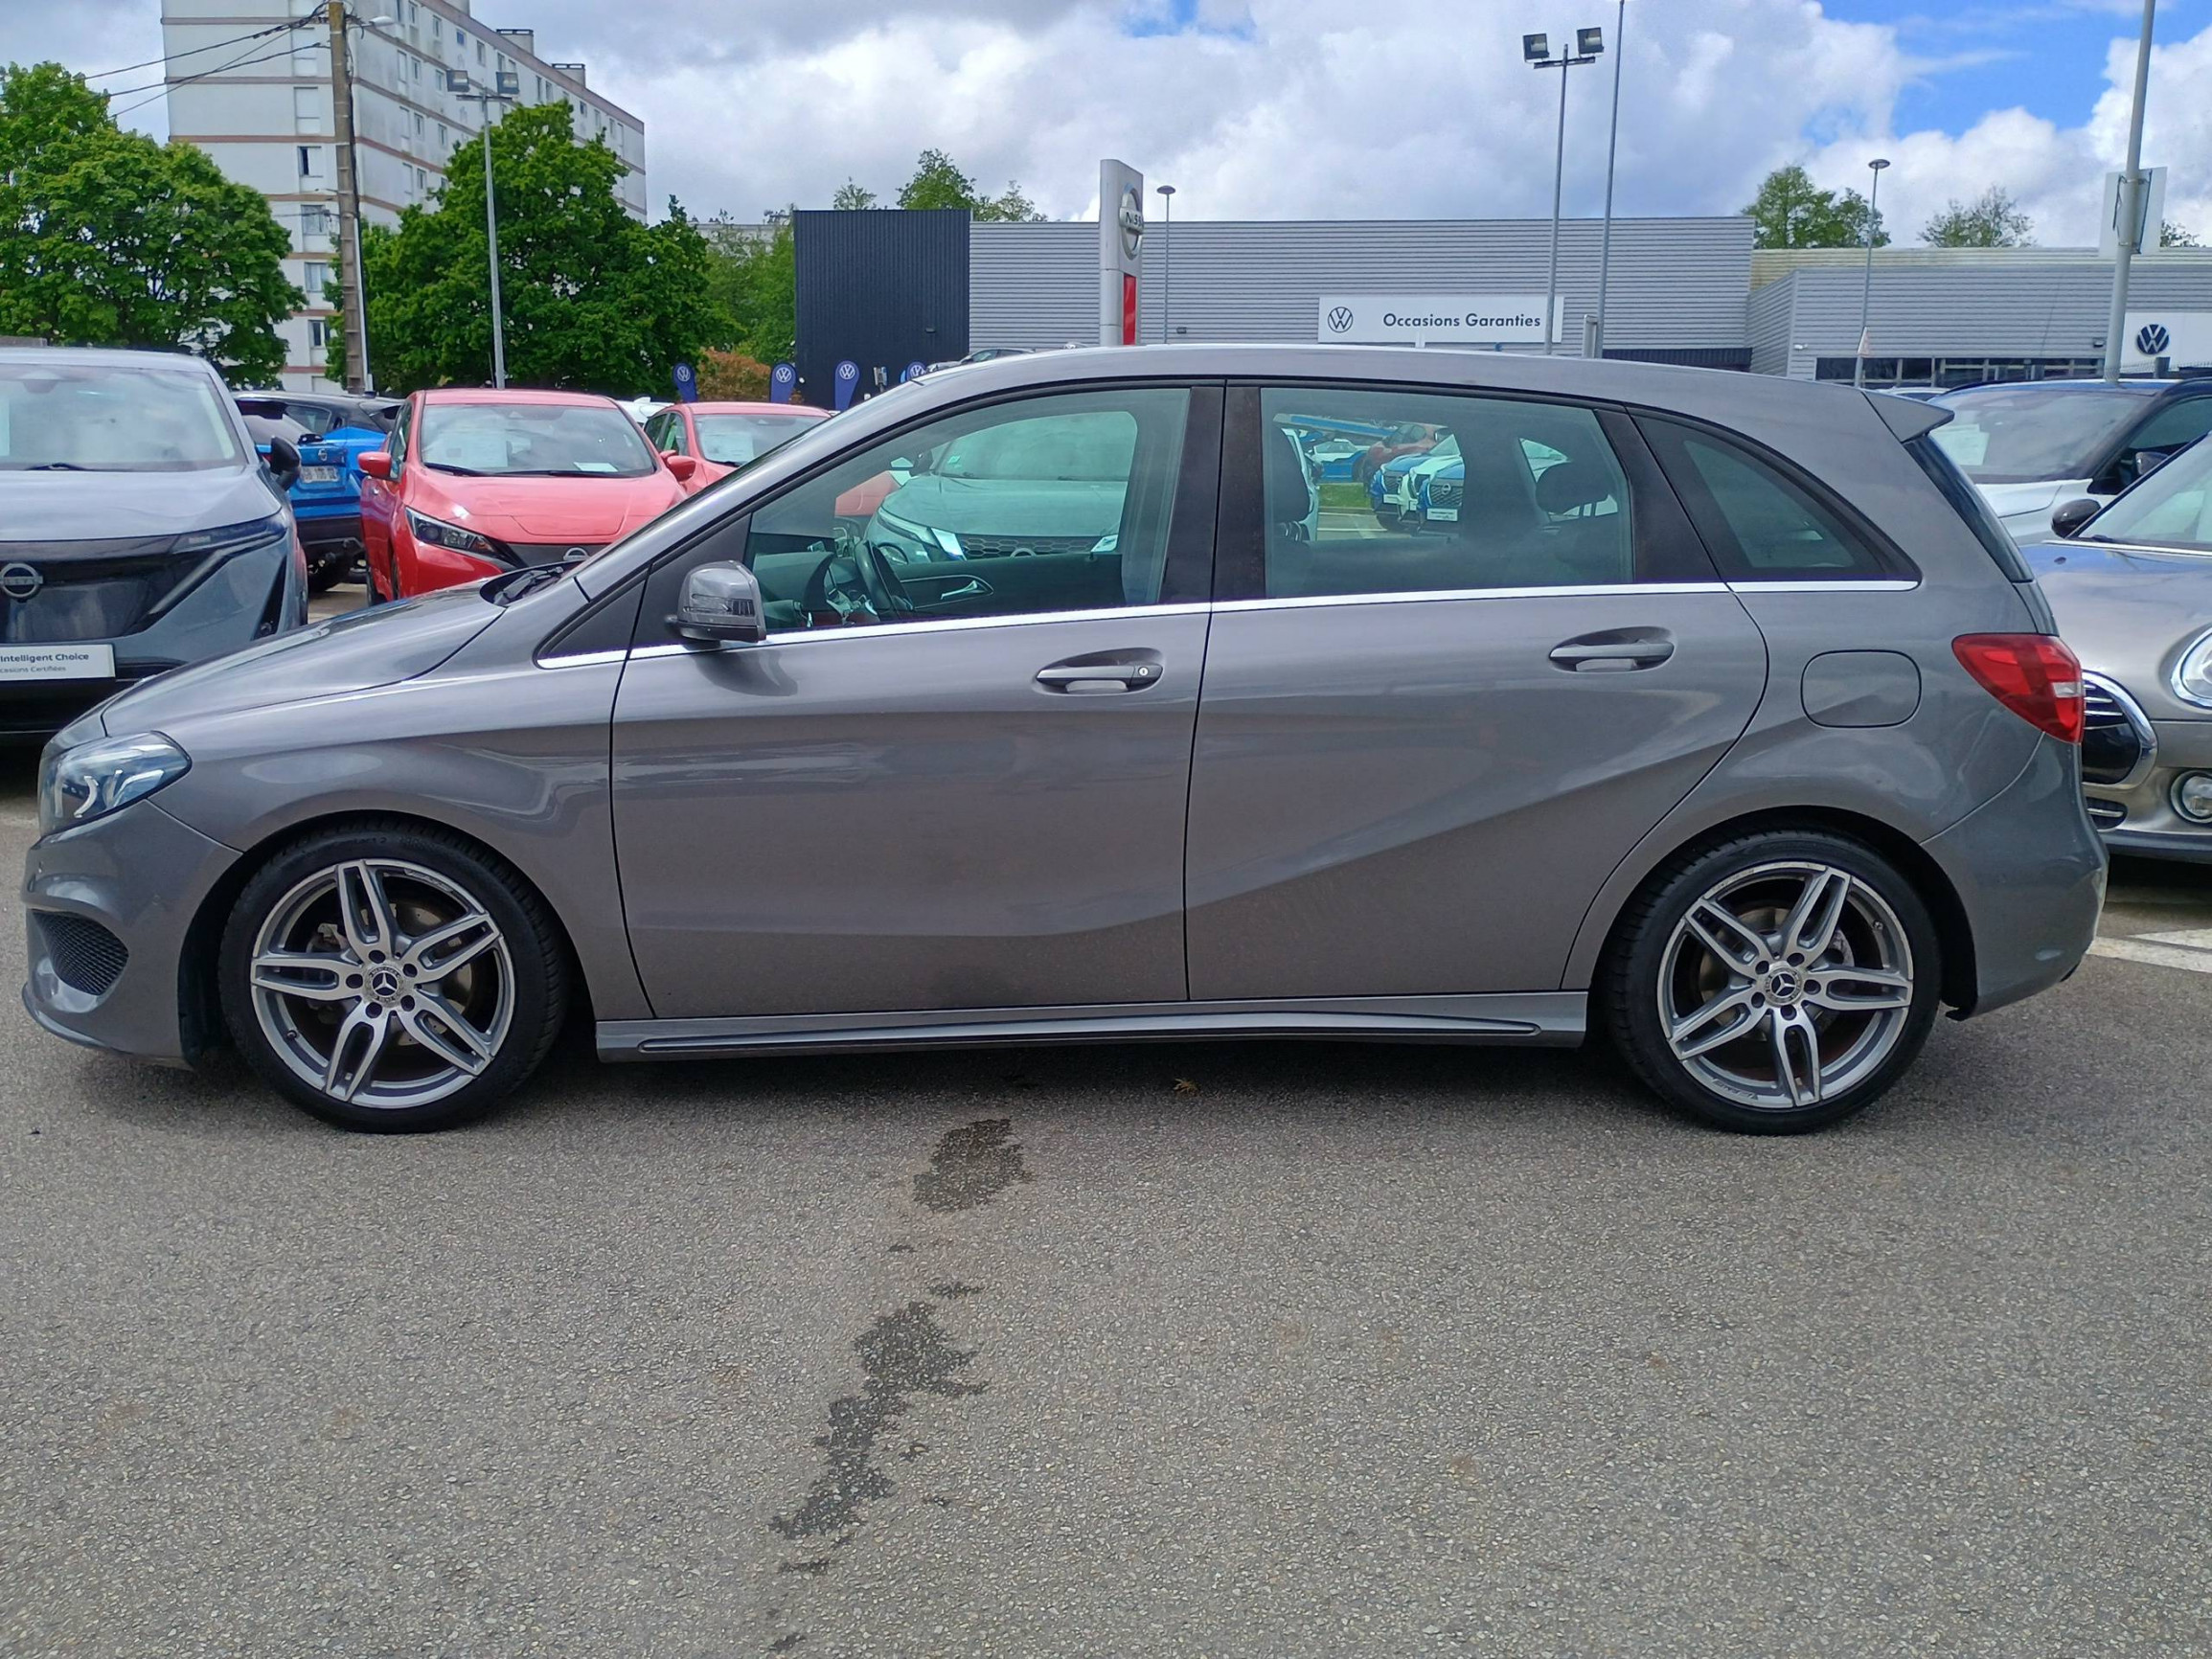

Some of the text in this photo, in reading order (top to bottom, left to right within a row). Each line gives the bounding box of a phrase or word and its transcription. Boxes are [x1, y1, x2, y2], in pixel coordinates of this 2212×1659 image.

[1383, 313, 1540, 327] Occasions Garanties
[0, 654, 53, 663] Intelligent
